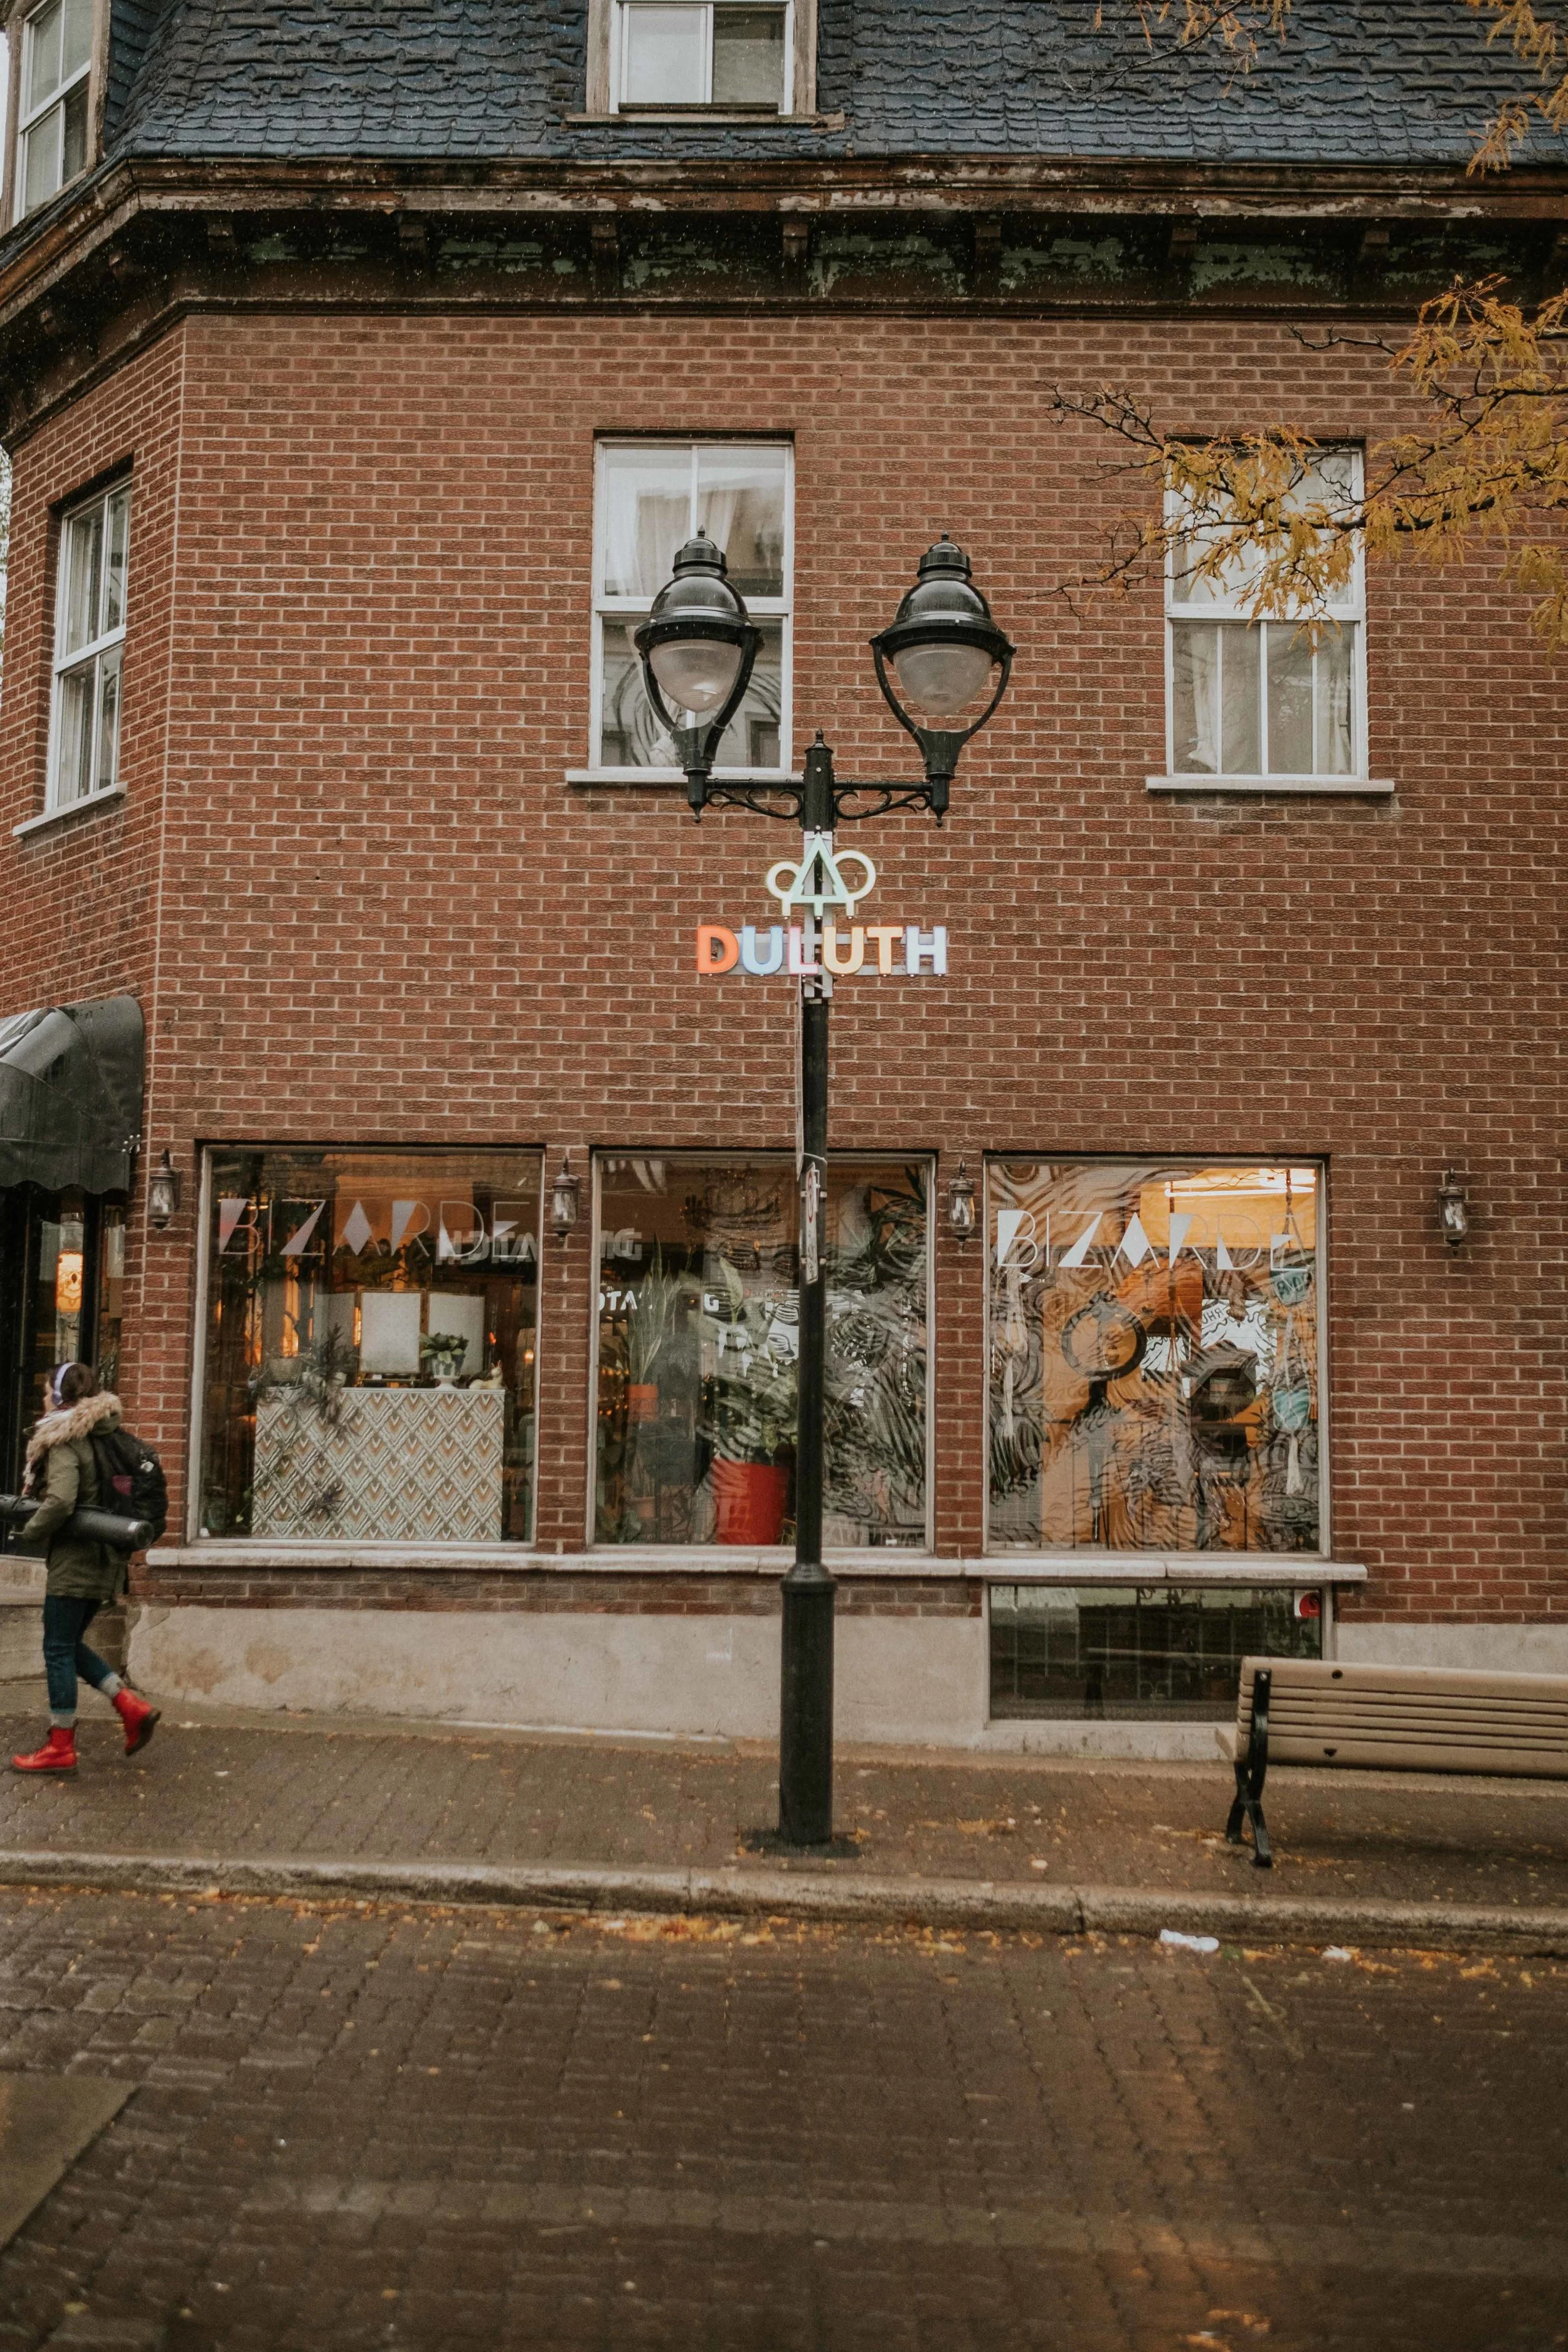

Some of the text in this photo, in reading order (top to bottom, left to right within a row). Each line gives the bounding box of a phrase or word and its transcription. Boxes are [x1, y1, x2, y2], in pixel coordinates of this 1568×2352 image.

[697, 926, 948, 975] DULUTH
[220, 1198, 531, 1257] BIZARDE
[997, 1210, 1308, 1272] BIZARDE
